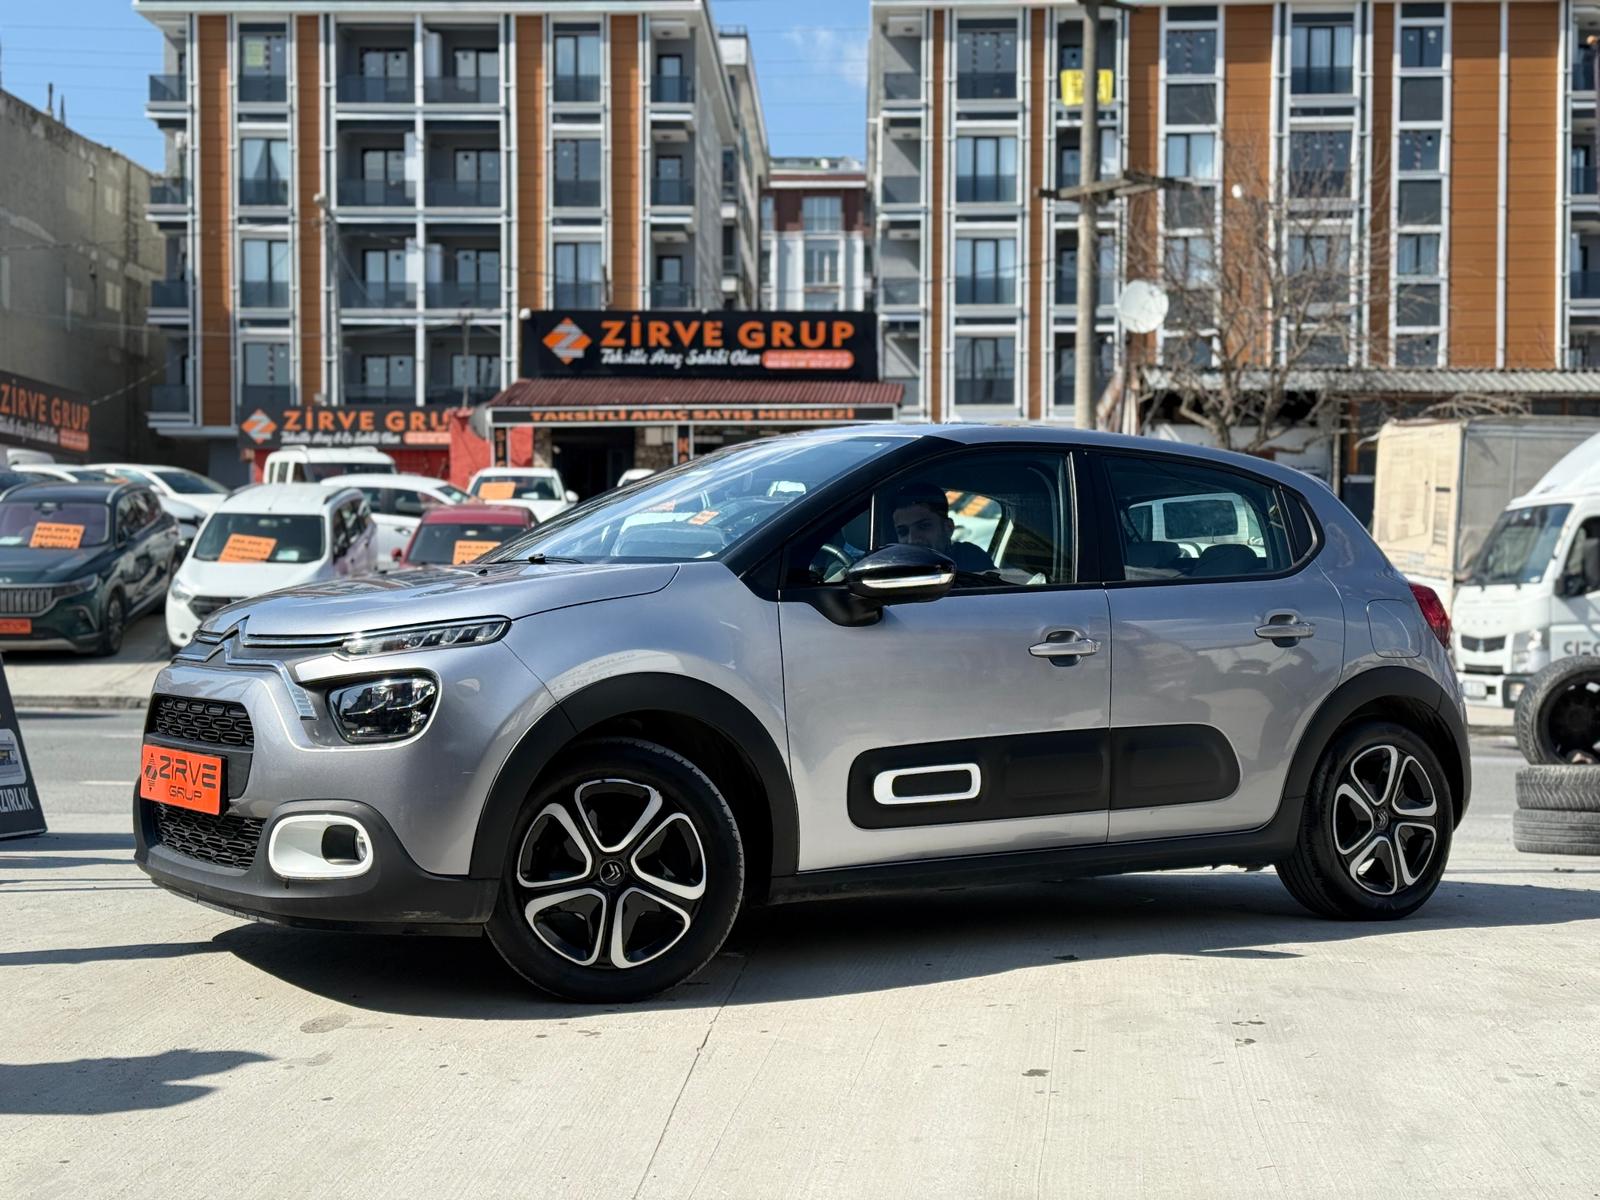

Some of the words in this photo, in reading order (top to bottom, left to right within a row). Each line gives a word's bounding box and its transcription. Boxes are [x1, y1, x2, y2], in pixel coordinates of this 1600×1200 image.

[600, 314, 723, 347] ZİRVE
[737, 320, 855, 349] GRUP
[0, 378, 47, 423] ZİRVE
[51, 396, 90, 430] GRUP
[630, 410, 689, 422] ARAÇ
[283, 406, 375, 432] ZİRVE
[385, 410, 450, 431] GRU
[0, 787, 34, 813] ZIRLIK
[168, 785, 202, 801] GRUP
